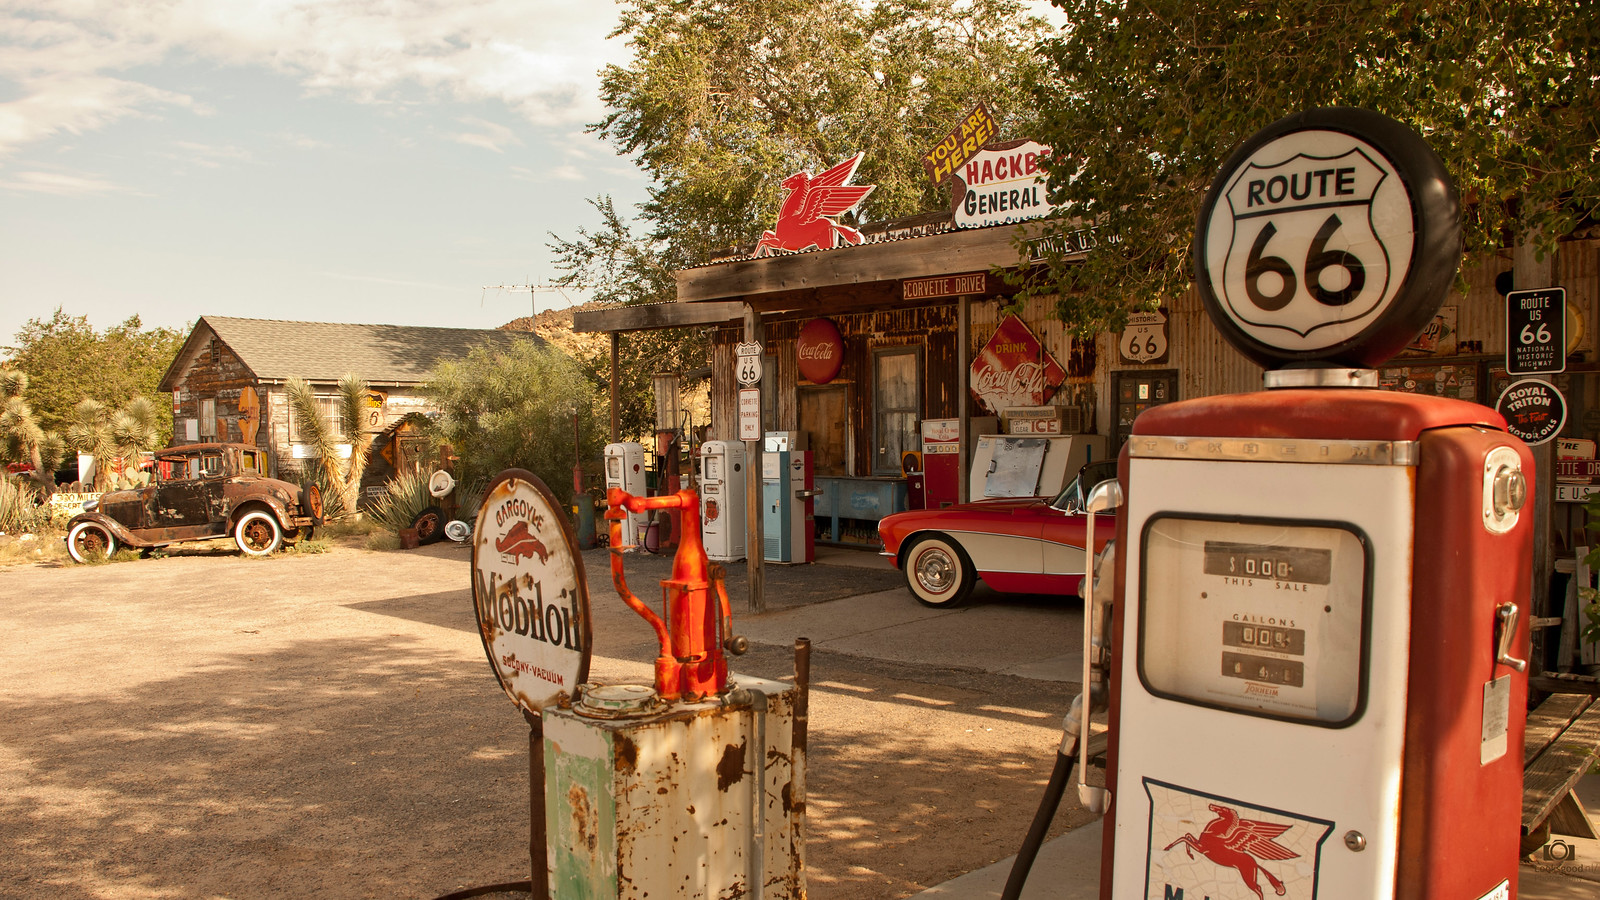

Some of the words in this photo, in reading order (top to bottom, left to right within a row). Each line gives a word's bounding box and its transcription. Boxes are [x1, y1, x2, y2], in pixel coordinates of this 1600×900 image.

[927, 134, 957, 165] YOU
[961, 108, 987, 139] ARE
[934, 118, 993, 183] HERE!
[1247, 167, 1356, 208] ROUTE
[964, 187, 1040, 217] GENERAL
[1245, 213, 1365, 311] 66
[907, 279, 949, 297] CORVETTE
[955, 275, 982, 294] DRIVE
[1520, 297, 1550, 310] ROUTE
[1530, 310, 1542, 321] US
[1520, 322, 1551, 345] 66
[741, 347, 757, 355] ROUTE
[995, 342, 1027, 354] DRINK
[1129, 335, 1157, 355] 66
[1516, 345, 1555, 353] NATIONAL
[1517, 352, 1554, 360] HISTORIC
[741, 365, 756, 380] 66
[741, 398, 758, 406] CORVETTE
[1508, 387, 1547, 401] ROYAL
[1507, 396, 1551, 412] TRITON
[1031, 419, 1057, 433] ICE
[1507, 424, 1539, 439] MOTOR
[1540, 418, 1557, 435] OILS
[1145, 441, 1370, 457] TOKHEIM
[495, 498, 545, 533] GARGOYLE
[1224, 577, 1254, 587] THIS
[1276, 582, 1309, 592] SALE
[477, 568, 582, 653] Mobiloil
[1233, 613, 1296, 627] GALLONS
